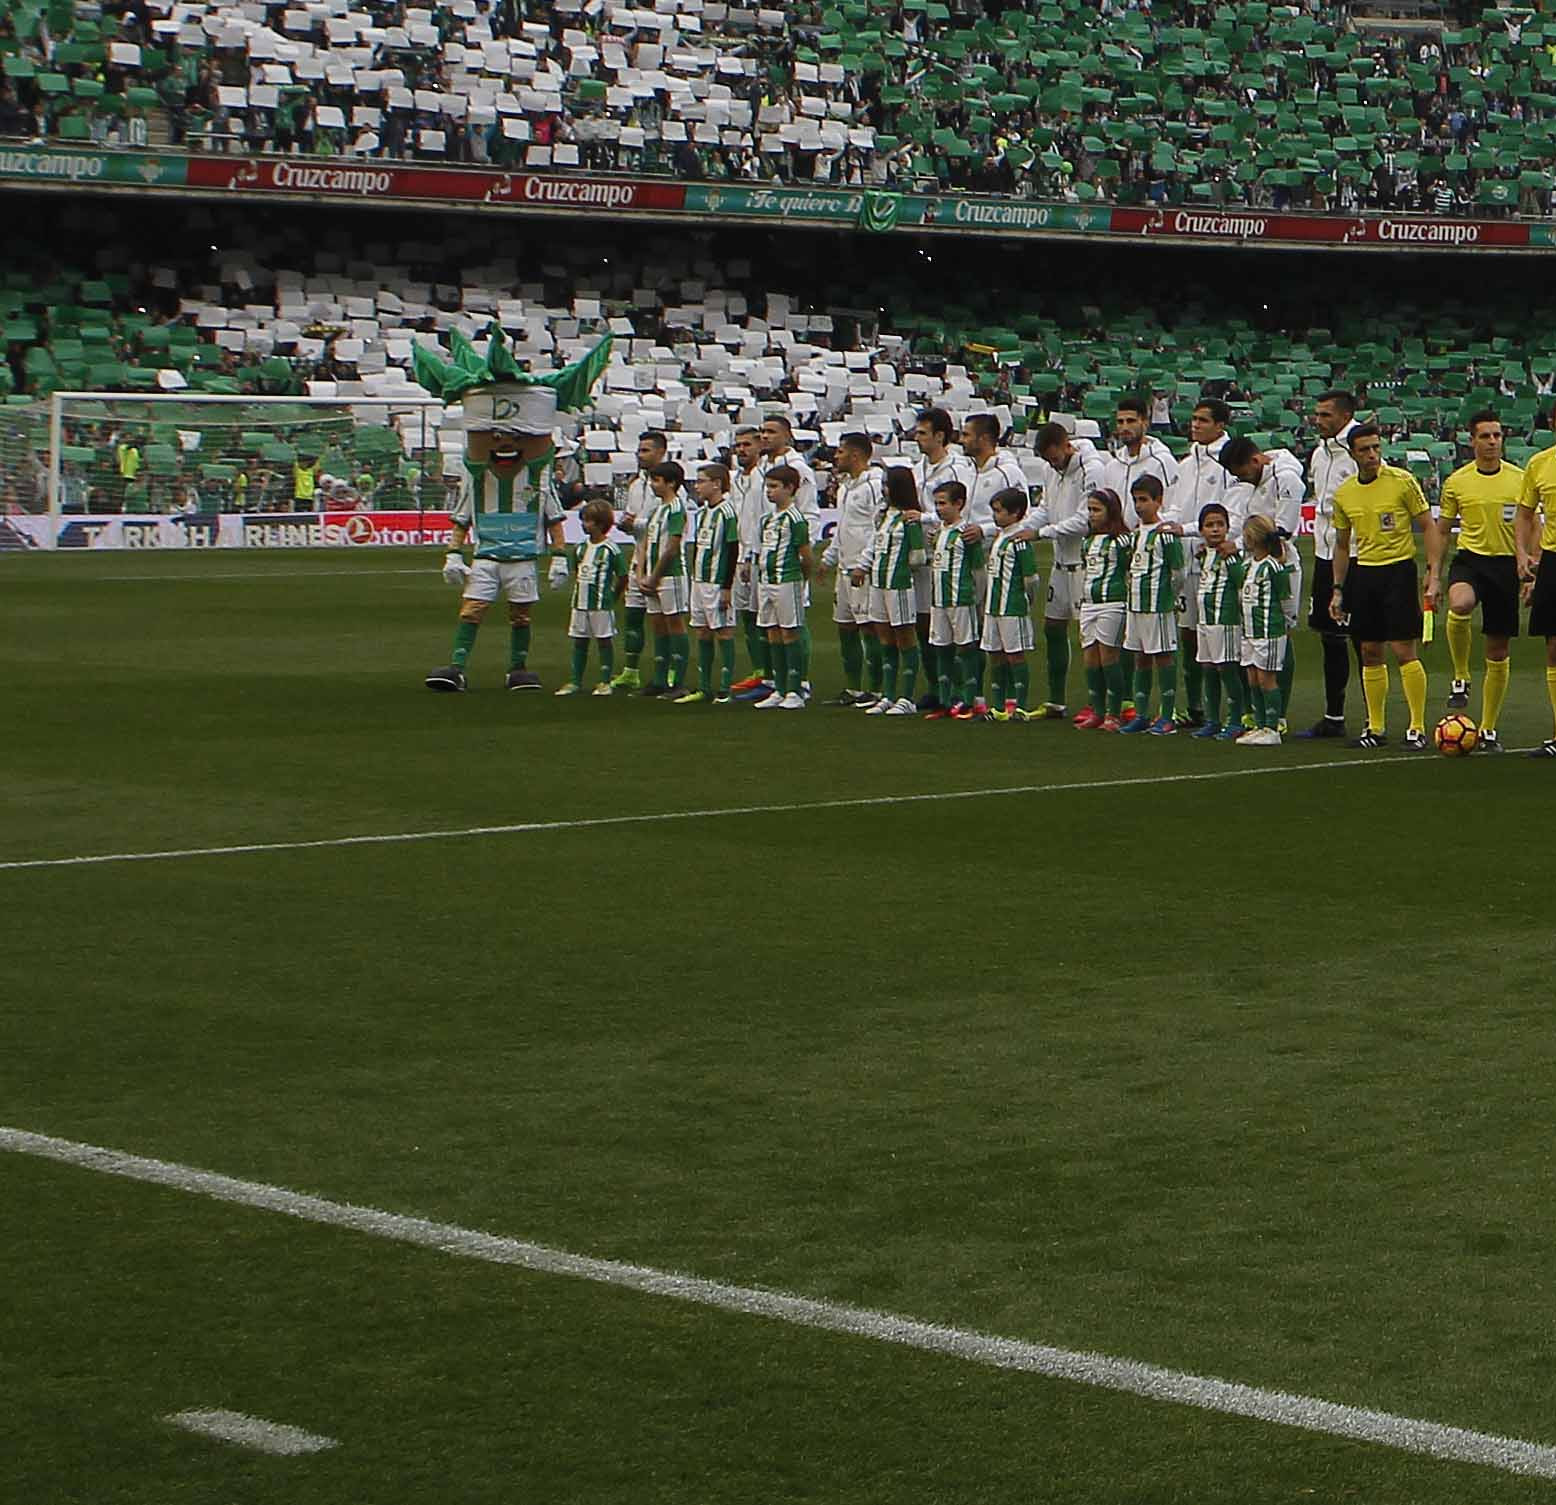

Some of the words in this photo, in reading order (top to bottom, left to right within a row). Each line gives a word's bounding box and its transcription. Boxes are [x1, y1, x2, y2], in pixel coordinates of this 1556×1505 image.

[273, 163, 390, 193] Cruzcampo
[526, 176, 633, 207] Cruzcampo
[956, 200, 1048, 227] Cruzcampo
[1175, 211, 1265, 237] Cruzcampo
[1379, 219, 1477, 244] Cruzcampo
